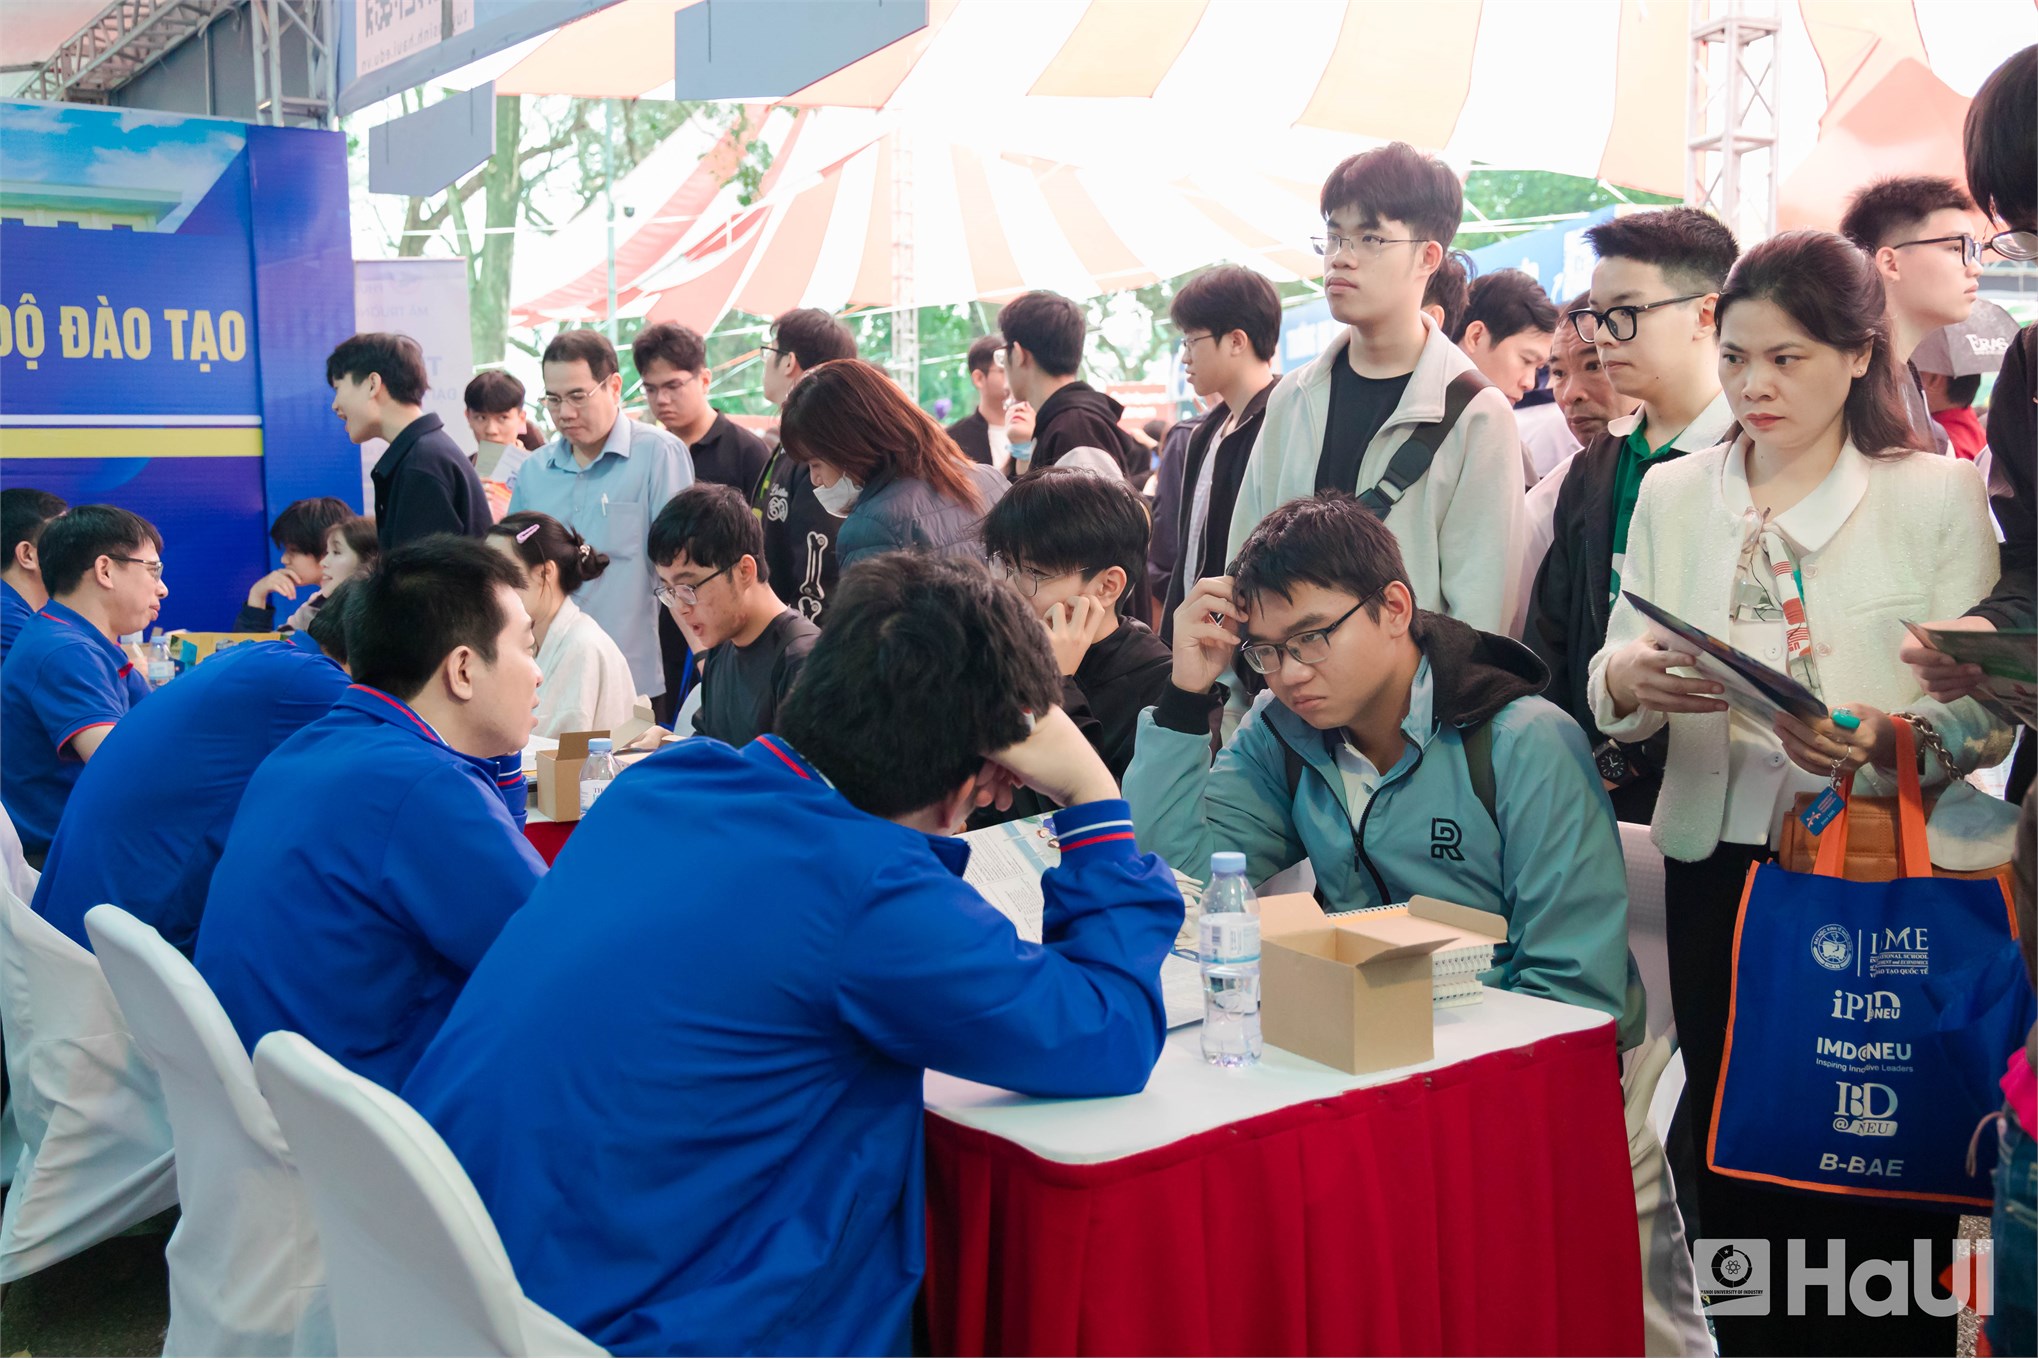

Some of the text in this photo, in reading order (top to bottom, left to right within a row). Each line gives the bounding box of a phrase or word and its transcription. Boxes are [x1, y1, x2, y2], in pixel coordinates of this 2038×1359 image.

[59, 295, 152, 361] ĐÀO
[164, 308, 247, 373] TẠO
[1815, 1057, 1847, 1072] Inspiring
[1881, 1064, 1914, 1073] Leaders
[1819, 1152, 1905, 1177] B-BAE
